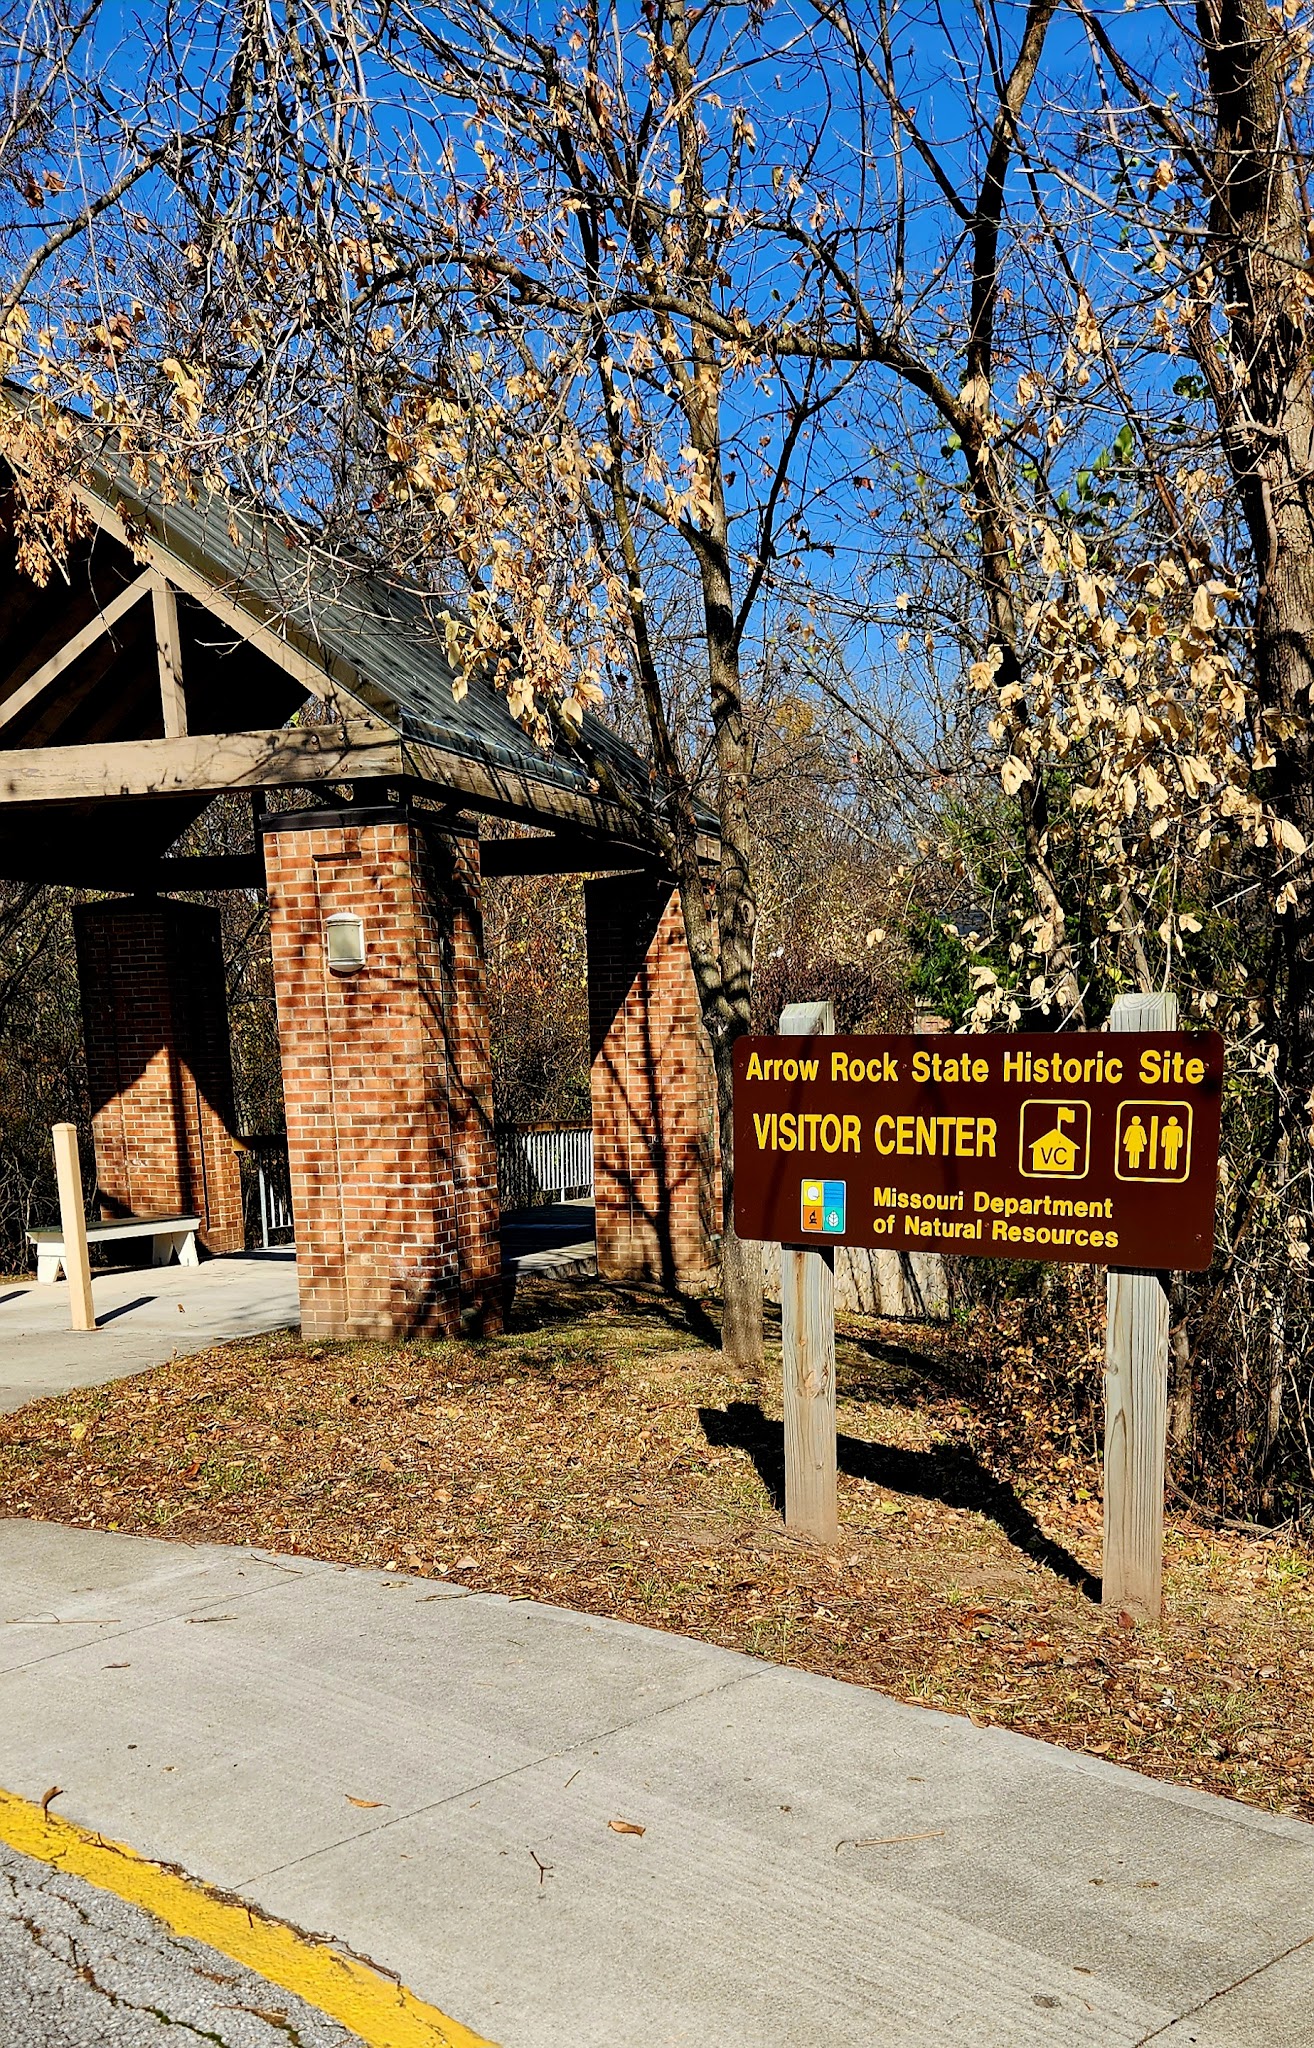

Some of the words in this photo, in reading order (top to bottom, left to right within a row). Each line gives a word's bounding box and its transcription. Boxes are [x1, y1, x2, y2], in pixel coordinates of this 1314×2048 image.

[746, 1053, 819, 1081] Arrow
[832, 1052, 898, 1082] Rock
[912, 1051, 989, 1082] State
[1004, 1051, 1122, 1083] Historic
[1138, 1050, 1205, 1084] Site
[753, 1113, 861, 1153] VISITOR
[875, 1115, 996, 1157] CENTER
[1042, 1148, 1067, 1165] VC
[874, 1187, 963, 1210] Missouri
[974, 1192, 1113, 1218] Department
[874, 1215, 895, 1233] of
[905, 1215, 982, 1239] Natural
[992, 1220, 1118, 1247] Resources
